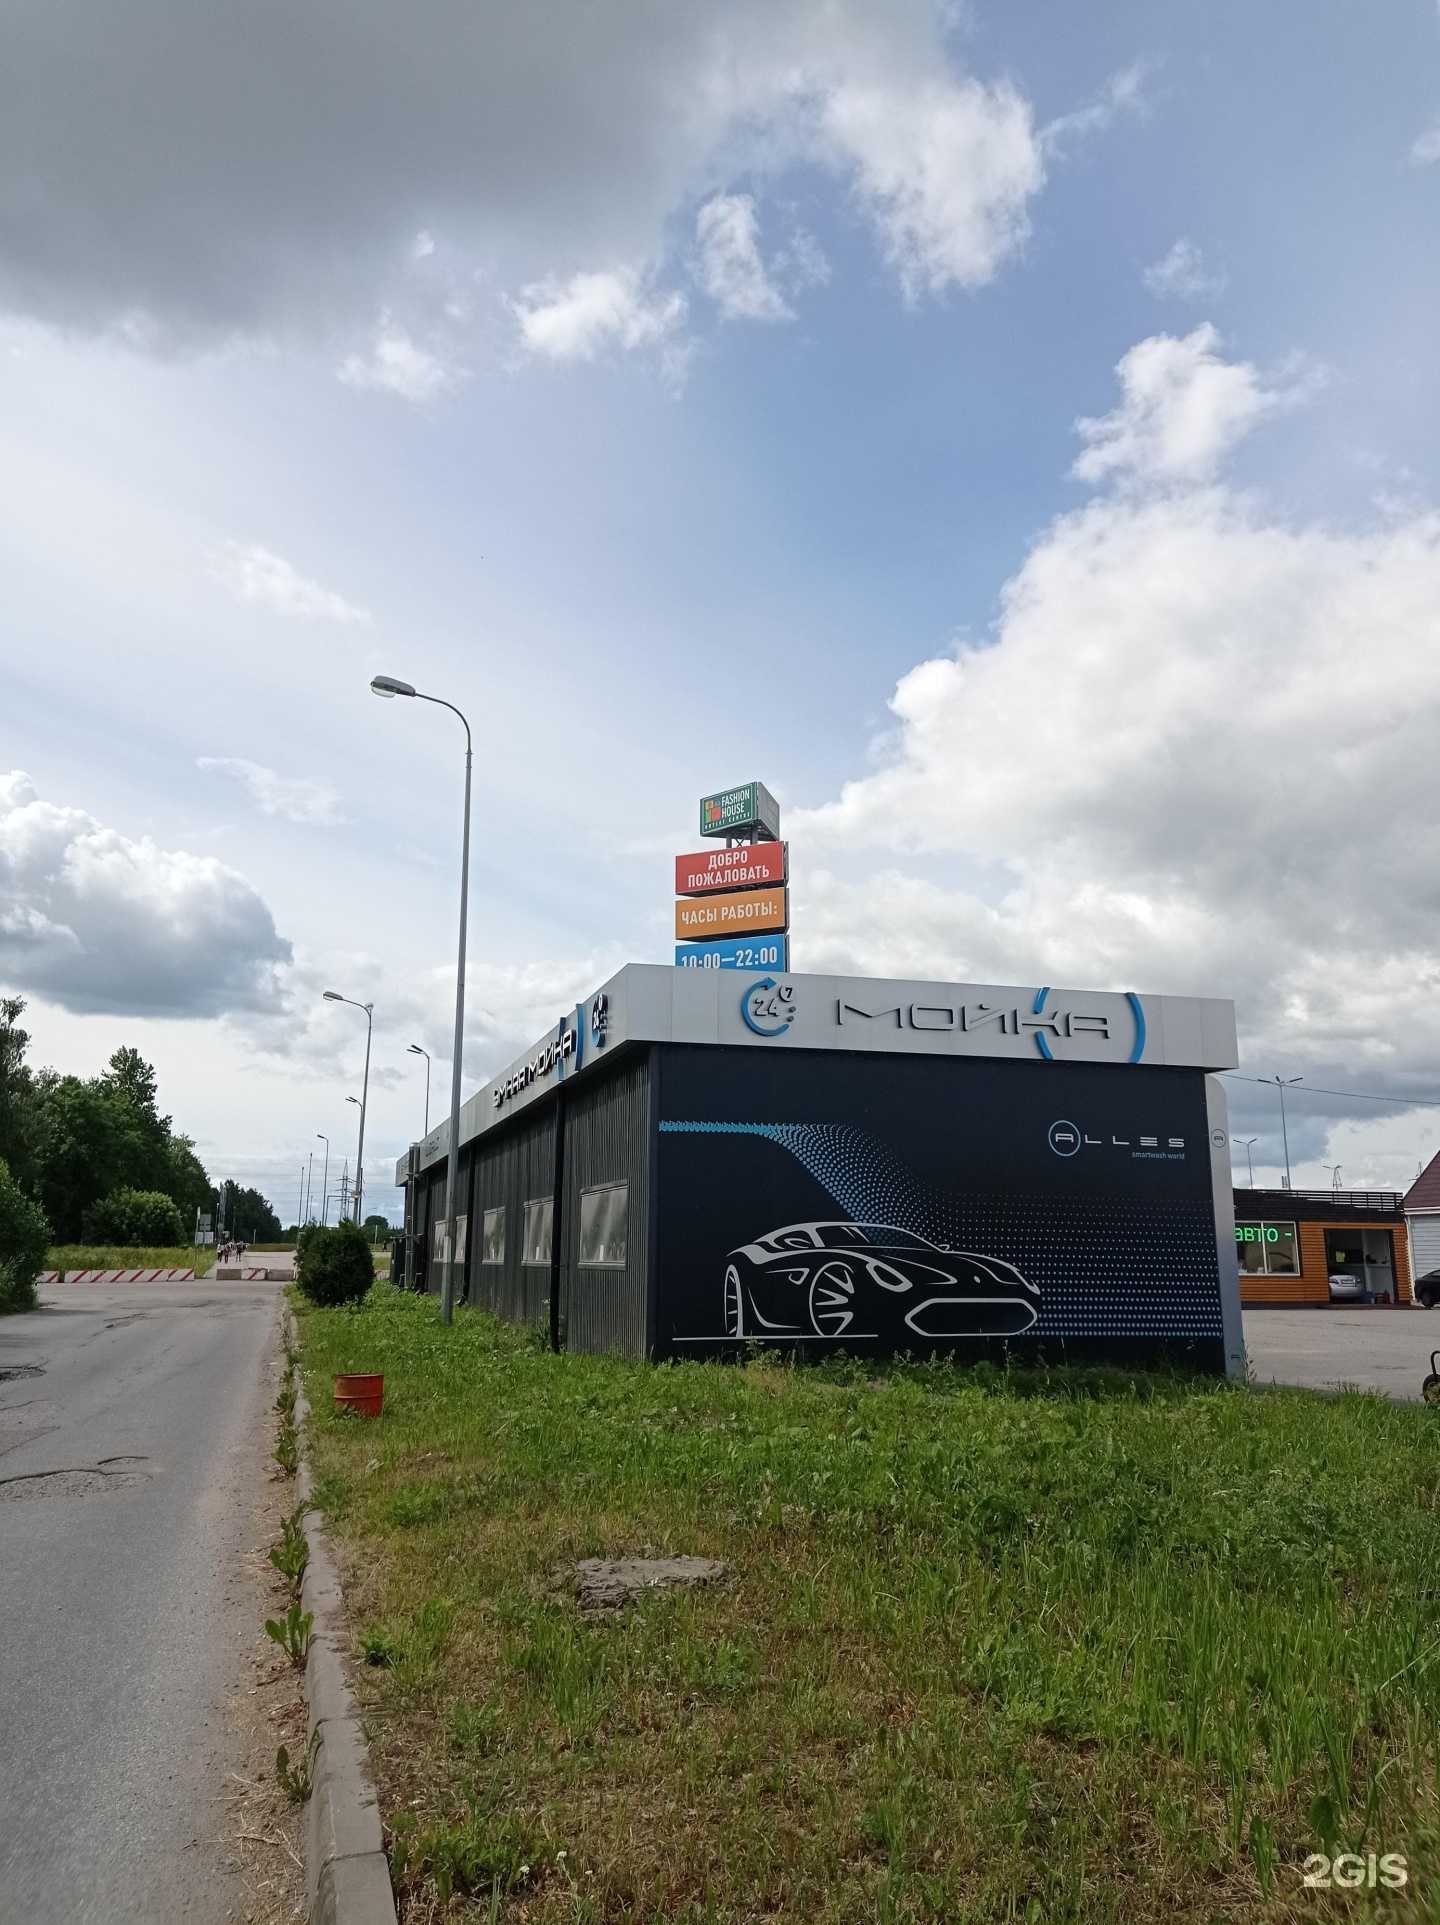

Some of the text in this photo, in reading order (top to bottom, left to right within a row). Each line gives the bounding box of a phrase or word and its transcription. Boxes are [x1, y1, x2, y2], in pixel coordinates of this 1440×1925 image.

[721, 789, 750, 807] FASHION
[721, 802, 745, 818] HOUSE
[708, 850, 748, 870] ДОБРО
[688, 865, 770, 888] ПОЖАЛОВАТЬ
[681, 901, 778, 925] ЧАСЫ РАБОТЫ:
[836, 998, 1111, 1040] МОЙКА
